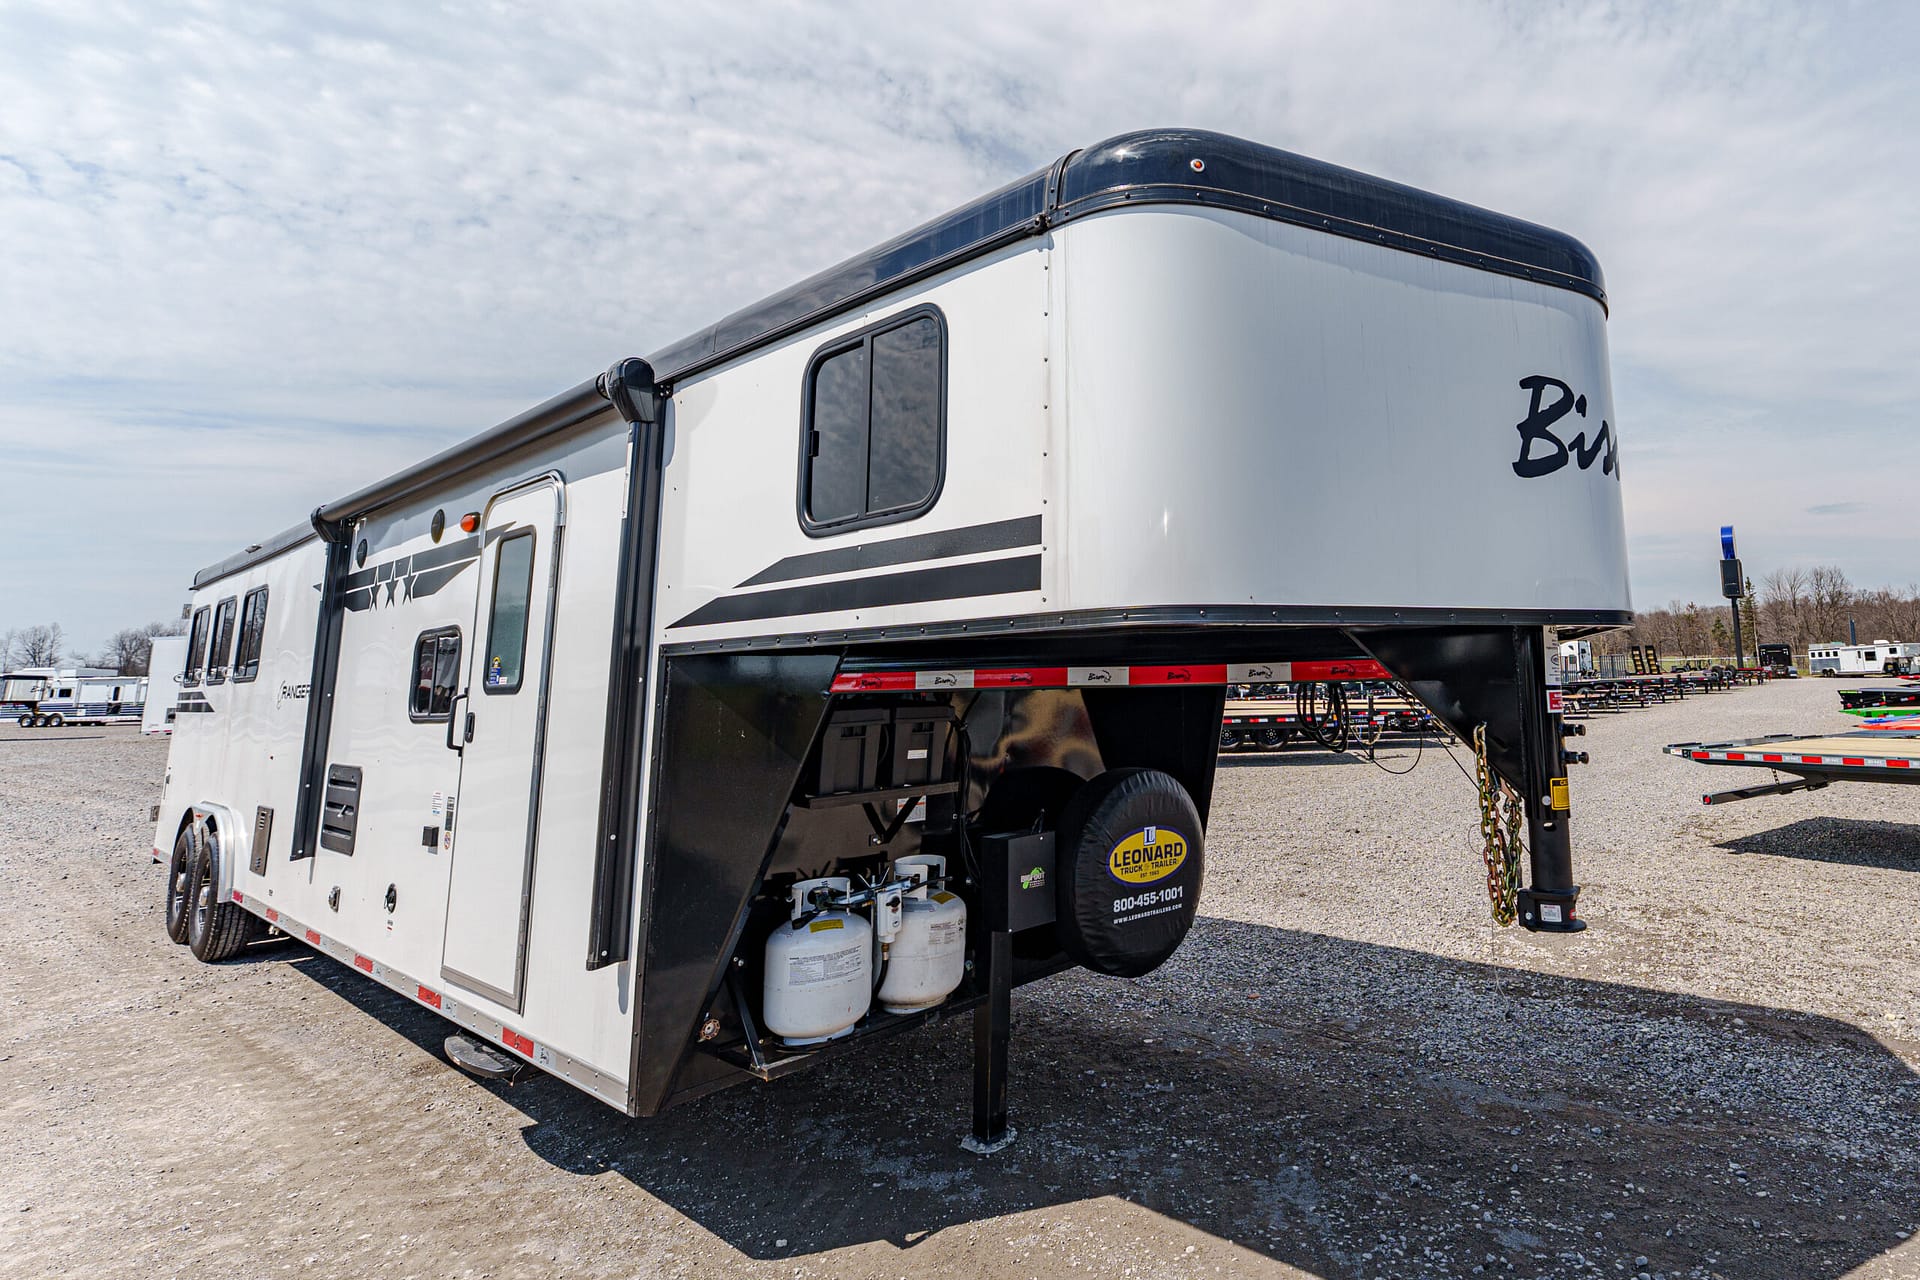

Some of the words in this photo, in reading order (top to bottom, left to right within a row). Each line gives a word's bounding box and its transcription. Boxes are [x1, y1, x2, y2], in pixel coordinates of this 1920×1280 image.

[1114, 842, 1183, 868] LEONARD
[1120, 864, 1143, 875] TRUCK
[1151, 858, 1177, 870] TRAILER
[1113, 885, 1183, 913] 800-455-1001
